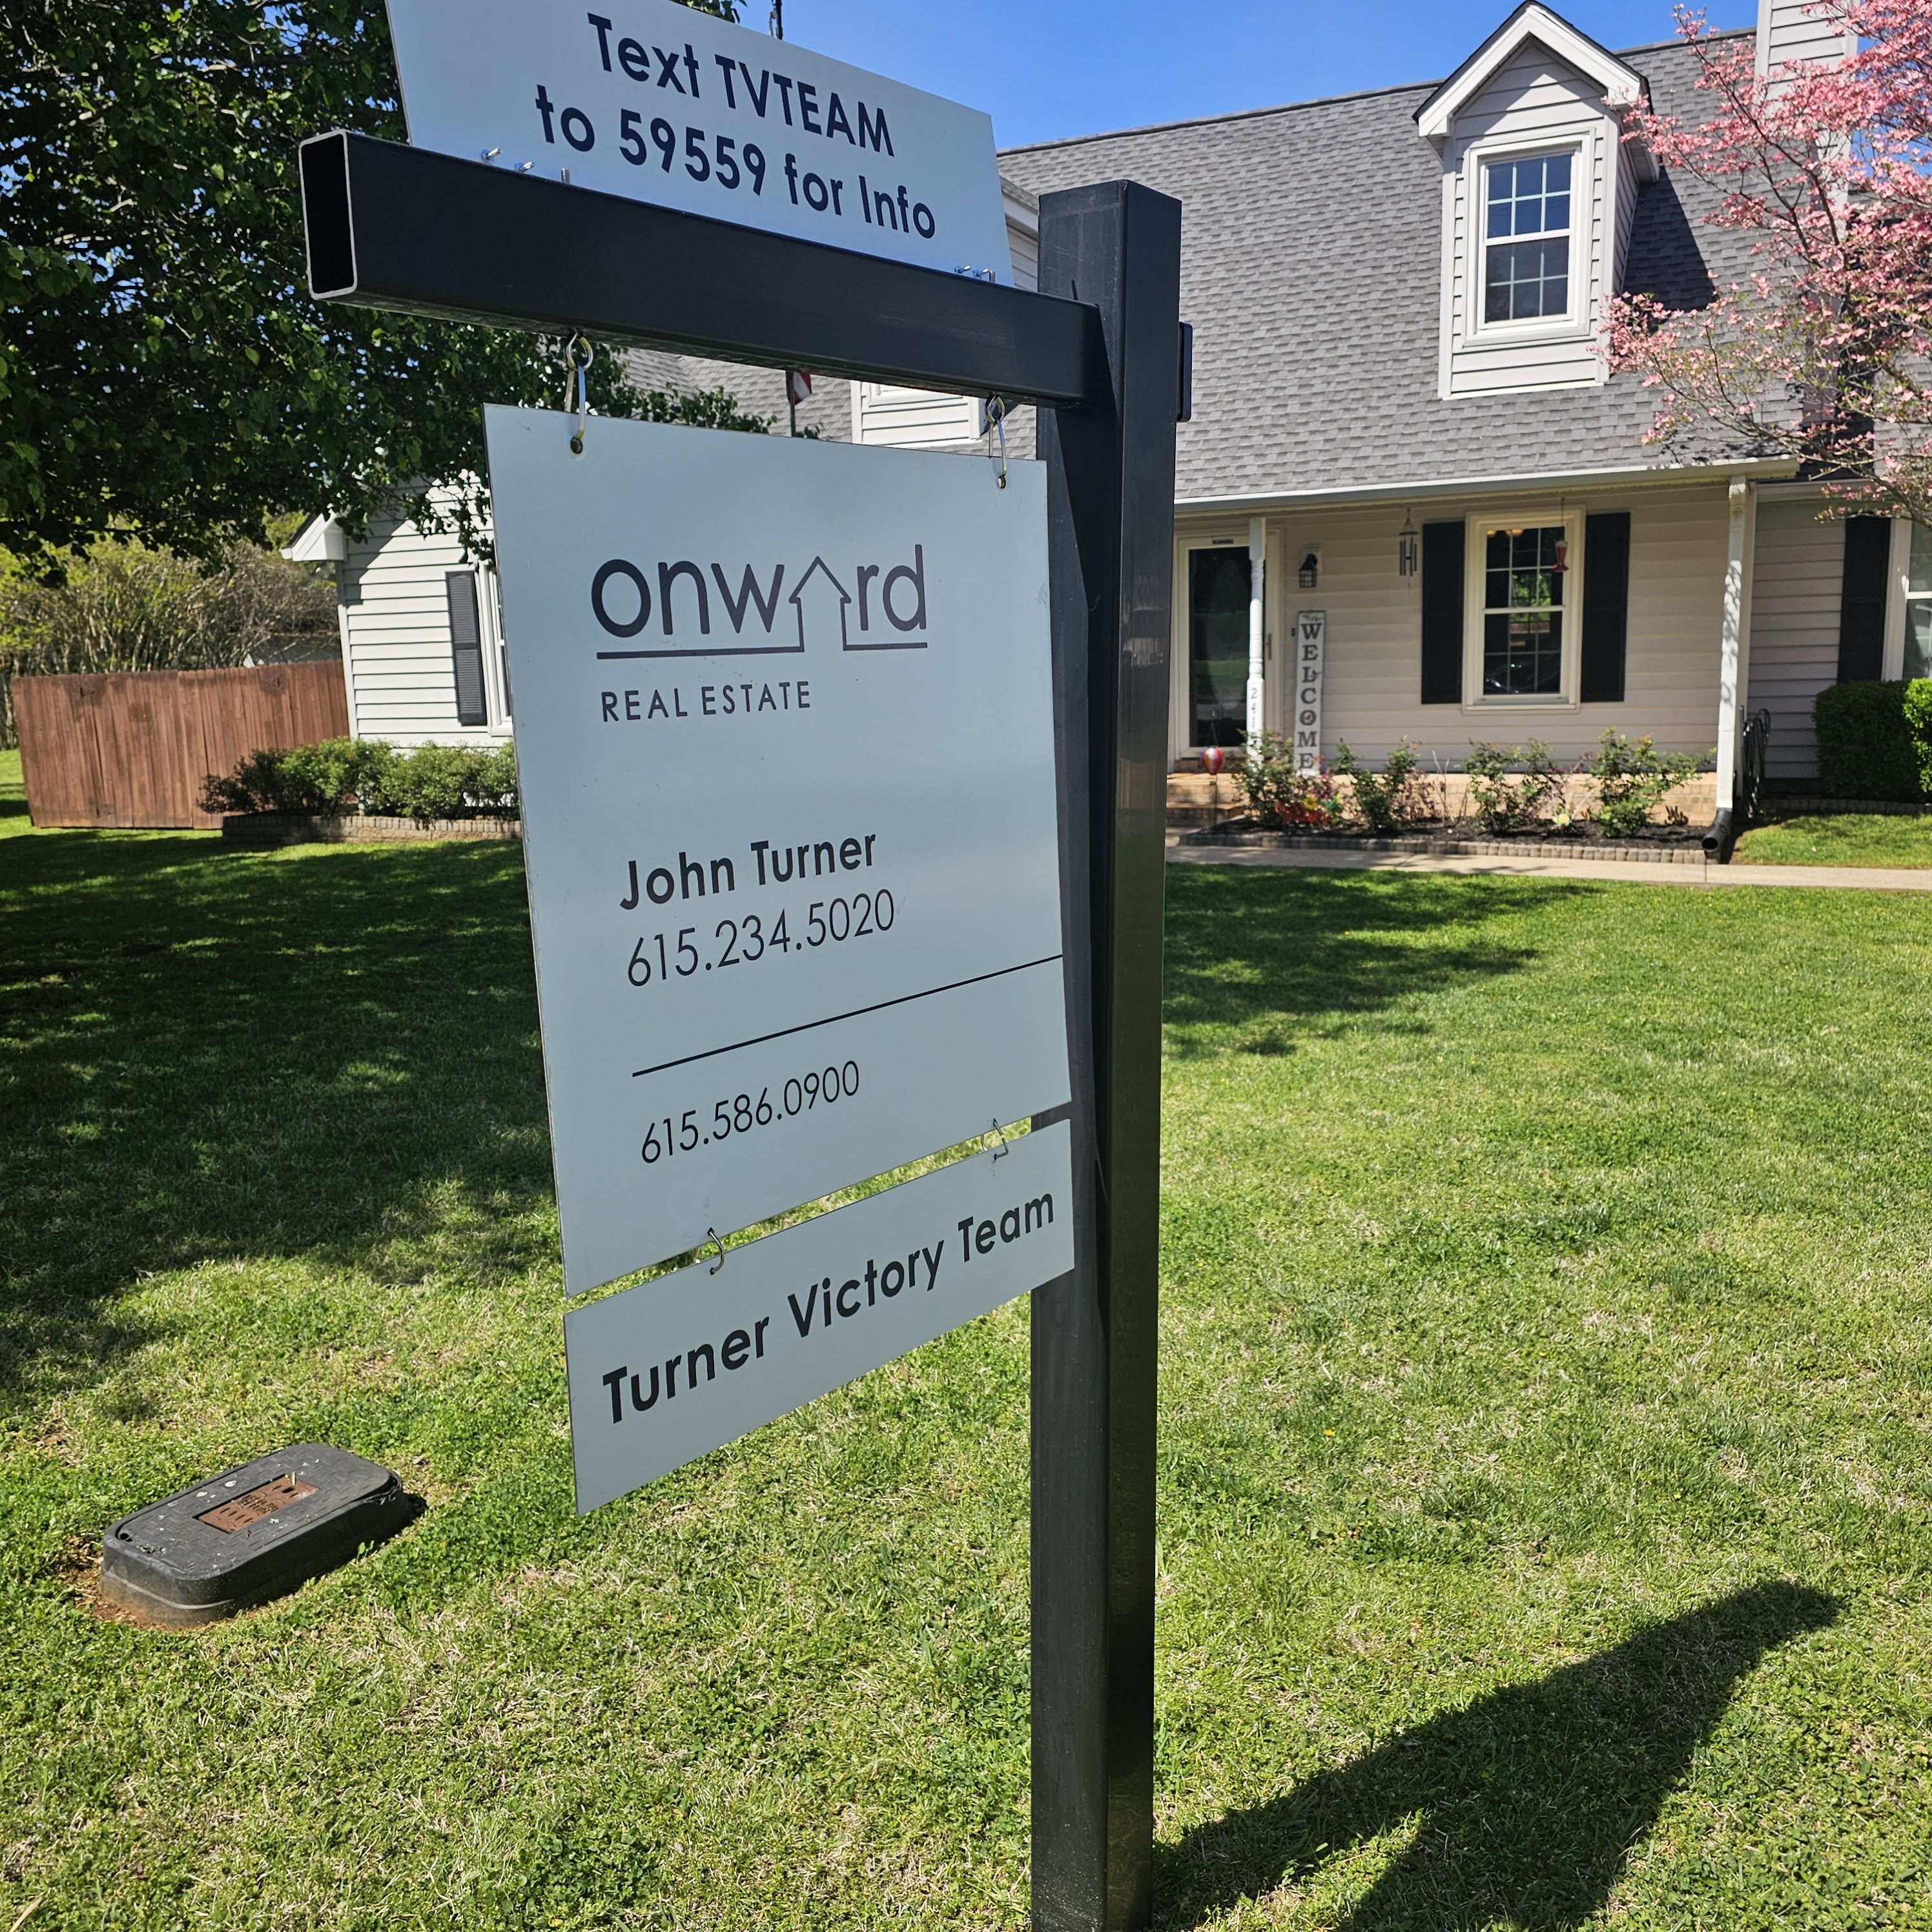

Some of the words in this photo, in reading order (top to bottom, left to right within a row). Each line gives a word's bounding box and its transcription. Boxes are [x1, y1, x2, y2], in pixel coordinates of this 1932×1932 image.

[588, 12, 699, 98] Text
[715, 54, 894, 157] TVTEAM
[535, 85, 595, 152] to
[620, 108, 766, 196] 59559
[785, 153, 843, 216] for
[859, 176, 935, 238] Info
[601, 688, 688, 722] REAL
[701, 681, 810, 715] ESTATE
[1297, 622, 1322, 770] WELCOME
[620, 852, 735, 910] John
[751, 834, 876, 885] Turner
[628, 889, 894, 987] 615.234.5020
[641, 1060, 859, 1164] 615.586.0900
[602, 1316, 769, 1424] Turner
[788, 1240, 944, 1337] Victory
[958, 1193, 1054, 1262] Team
